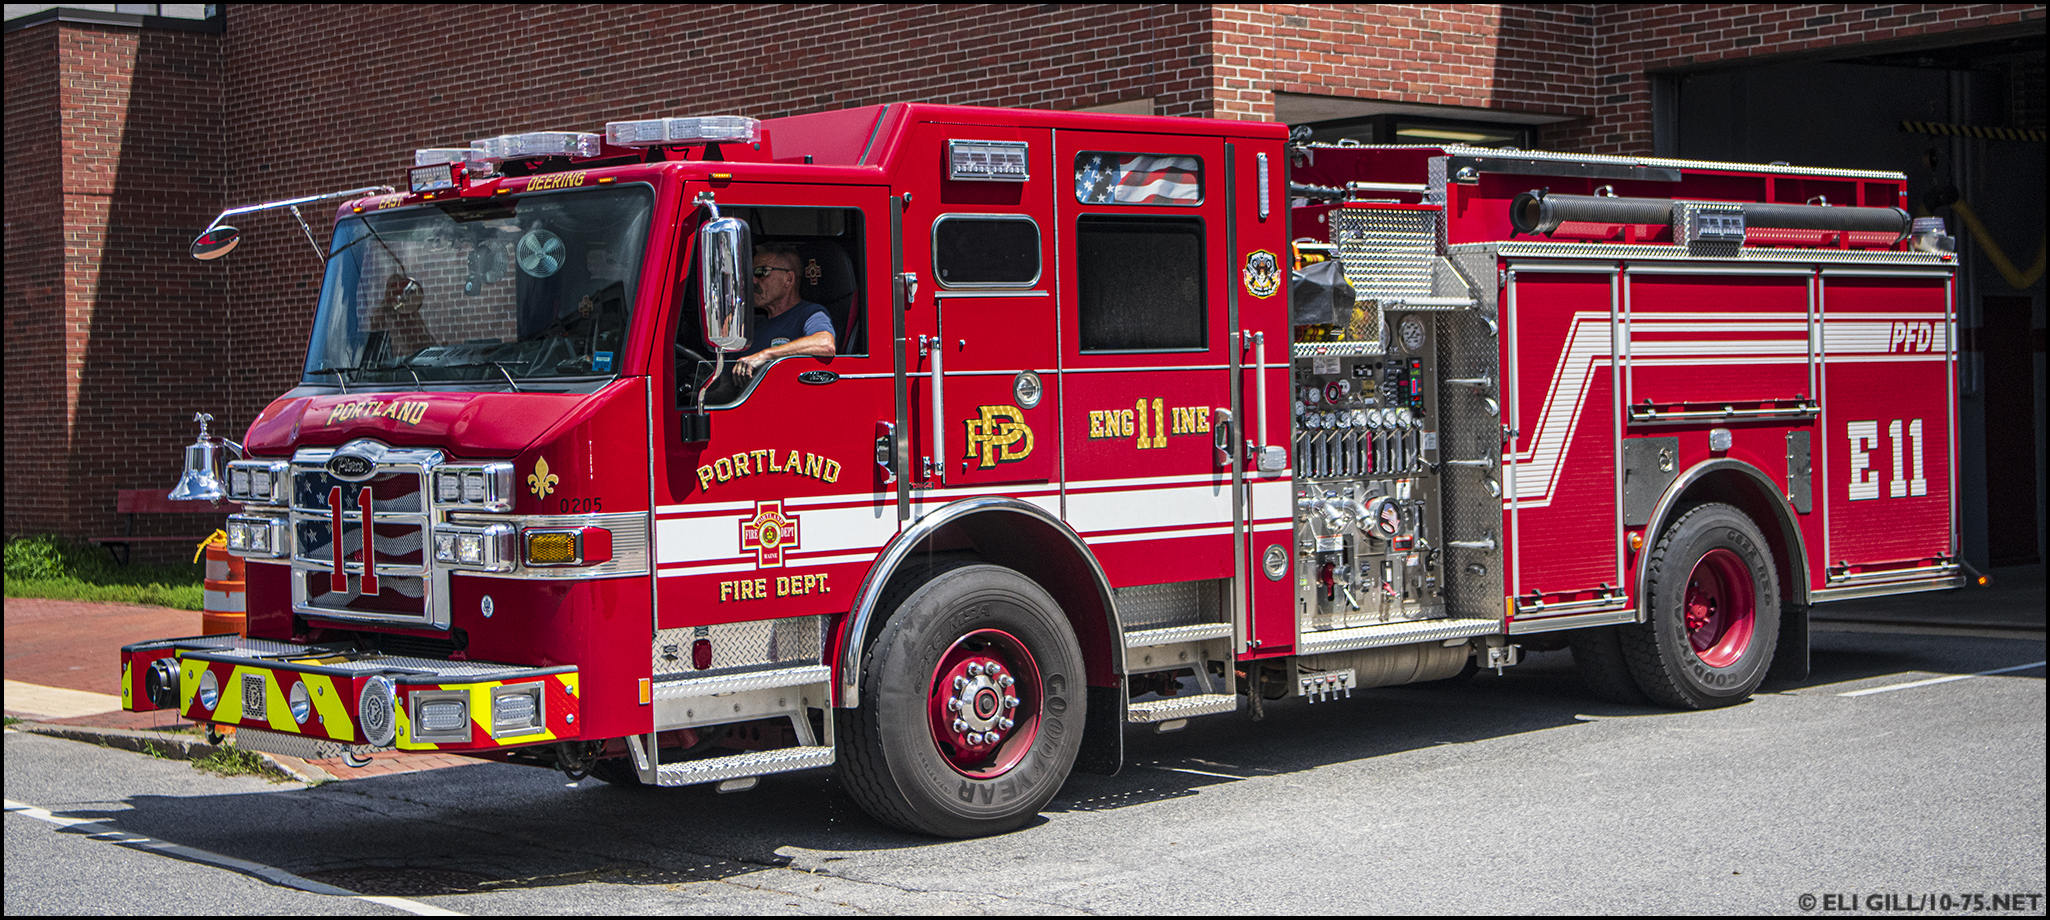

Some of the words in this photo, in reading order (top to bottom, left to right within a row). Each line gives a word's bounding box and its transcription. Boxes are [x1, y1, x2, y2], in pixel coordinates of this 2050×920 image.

[378, 193, 404, 209] EAST
[526, 172, 587, 192] DEERING
[1890, 321, 1932, 352] PFD
[327, 400, 428, 425] PORTLAND
[333, 456, 365, 475] Pierce
[696, 448, 841, 491] PORTLAND
[560, 497, 602, 513] 0205
[756, 513, 784, 526] PORTLAND
[328, 485, 380, 596] 11
[745, 529, 759, 540] FIRE
[780, 526, 794, 538] DEPT
[720, 578, 767, 601] FIRE
[776, 573, 830, 597] DEPT.
